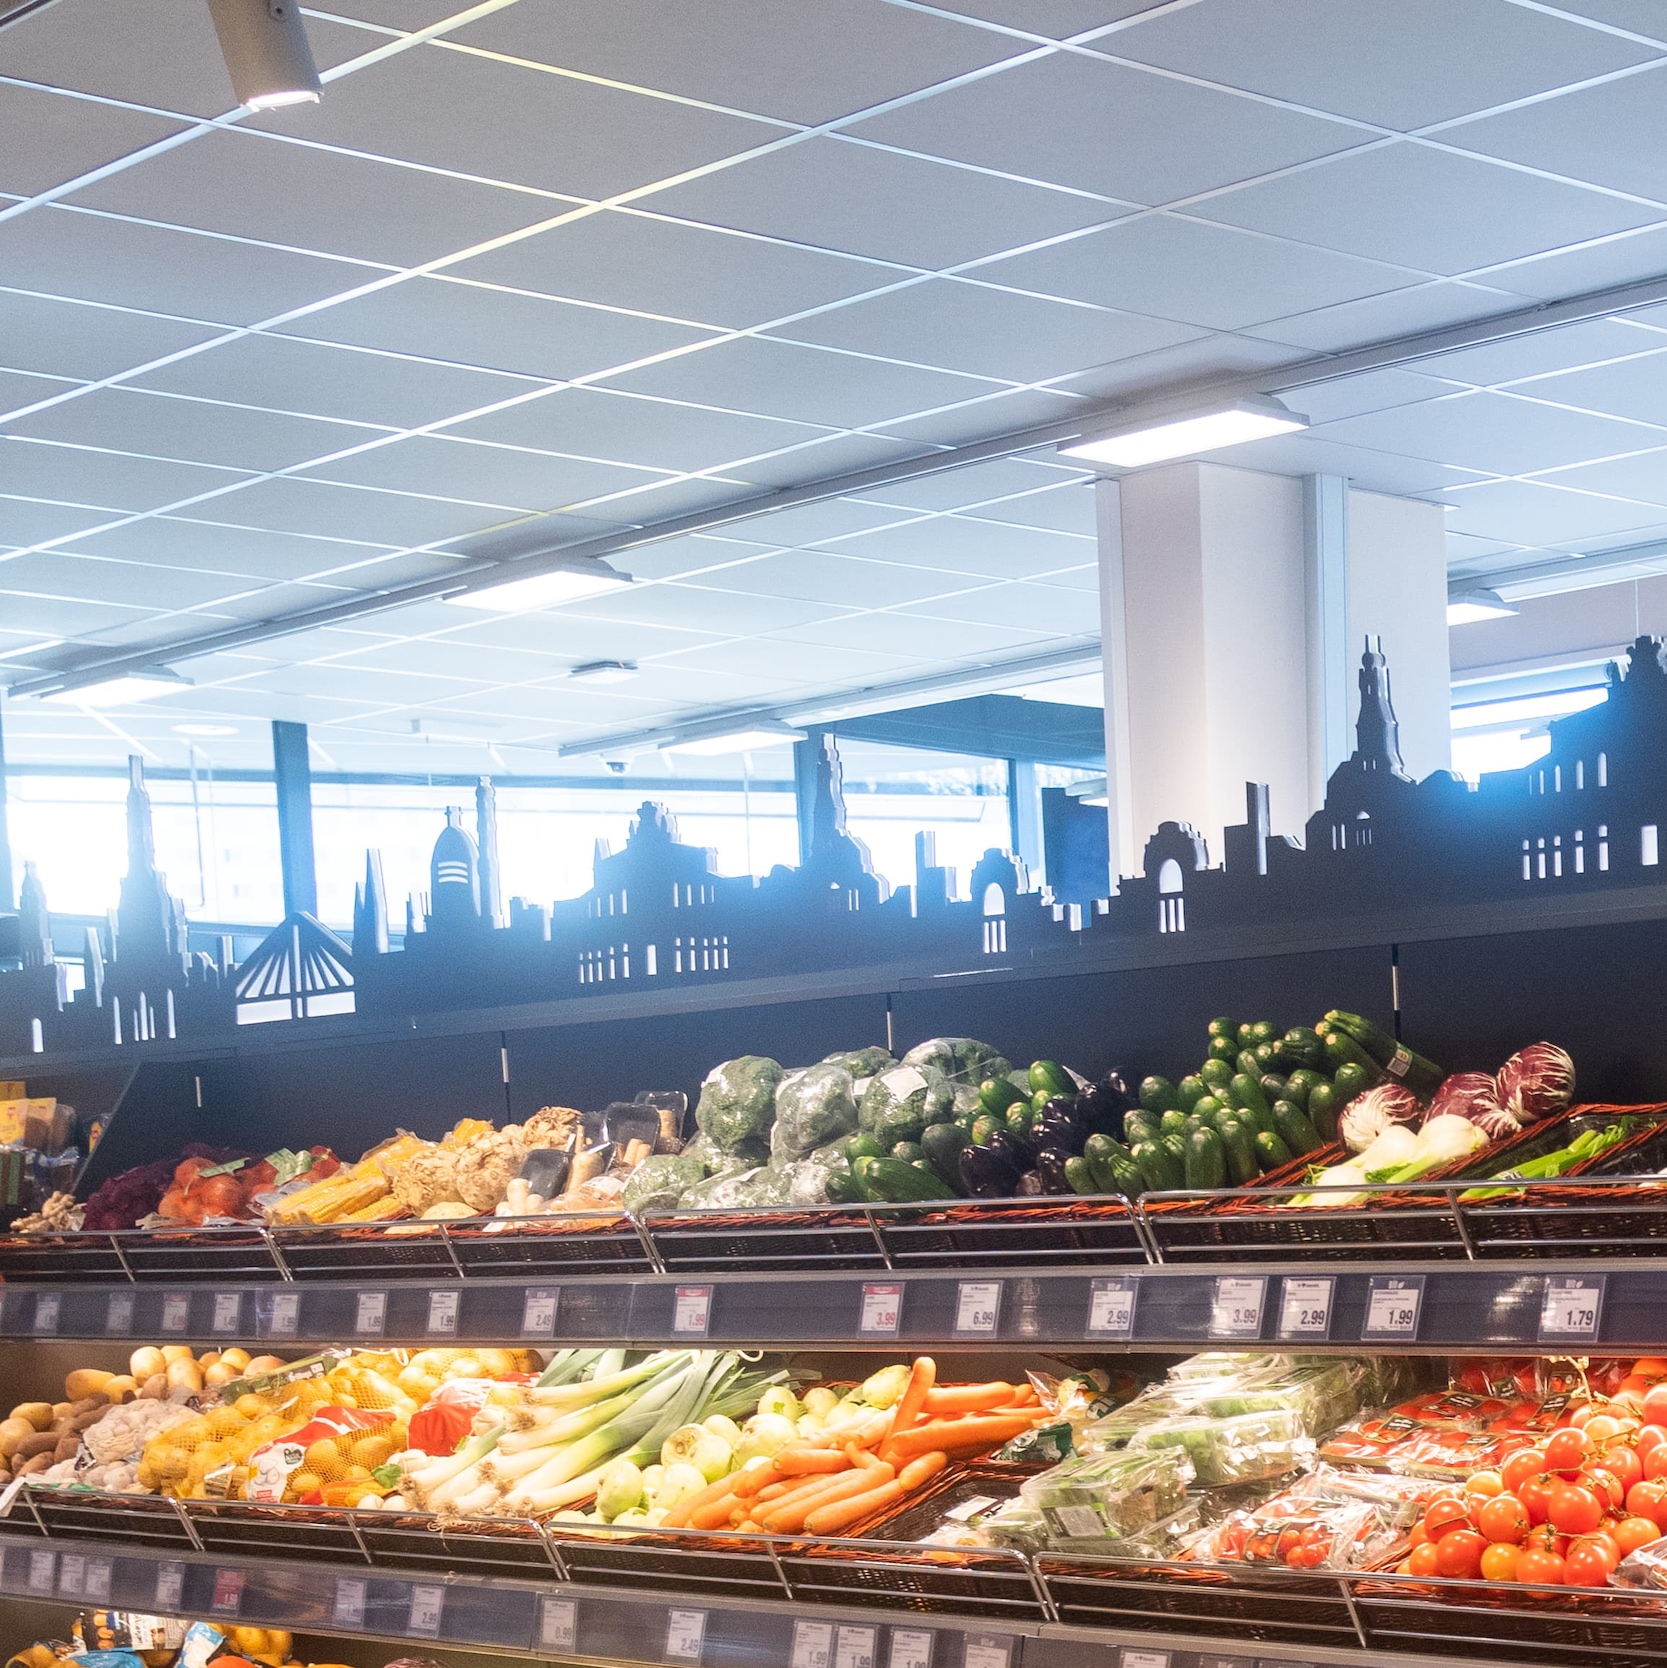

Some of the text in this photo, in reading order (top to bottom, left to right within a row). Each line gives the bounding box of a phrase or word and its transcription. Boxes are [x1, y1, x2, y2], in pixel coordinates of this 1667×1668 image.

[440, 1315, 453, 1326] 1.99
[536, 1314, 551, 1326] 2.49
[689, 1314, 705, 1325] 1.99
[876, 1313, 896, 1325] 3.99
[973, 1312, 993, 1325] 6.99
[1107, 1311, 1128, 1324] 2.99
[1233, 1309, 1256, 1323] 3.99
[1301, 1310, 1324, 1324] 2.99
[1389, 1310, 1412, 1324] 1.99
[1567, 1310, 1593, 1325] 1.79
[681, 1638, 698, 1652] 2.49
[809, 1651, 827, 1664] 1.99
[852, 1655, 871, 1668] 1.99
